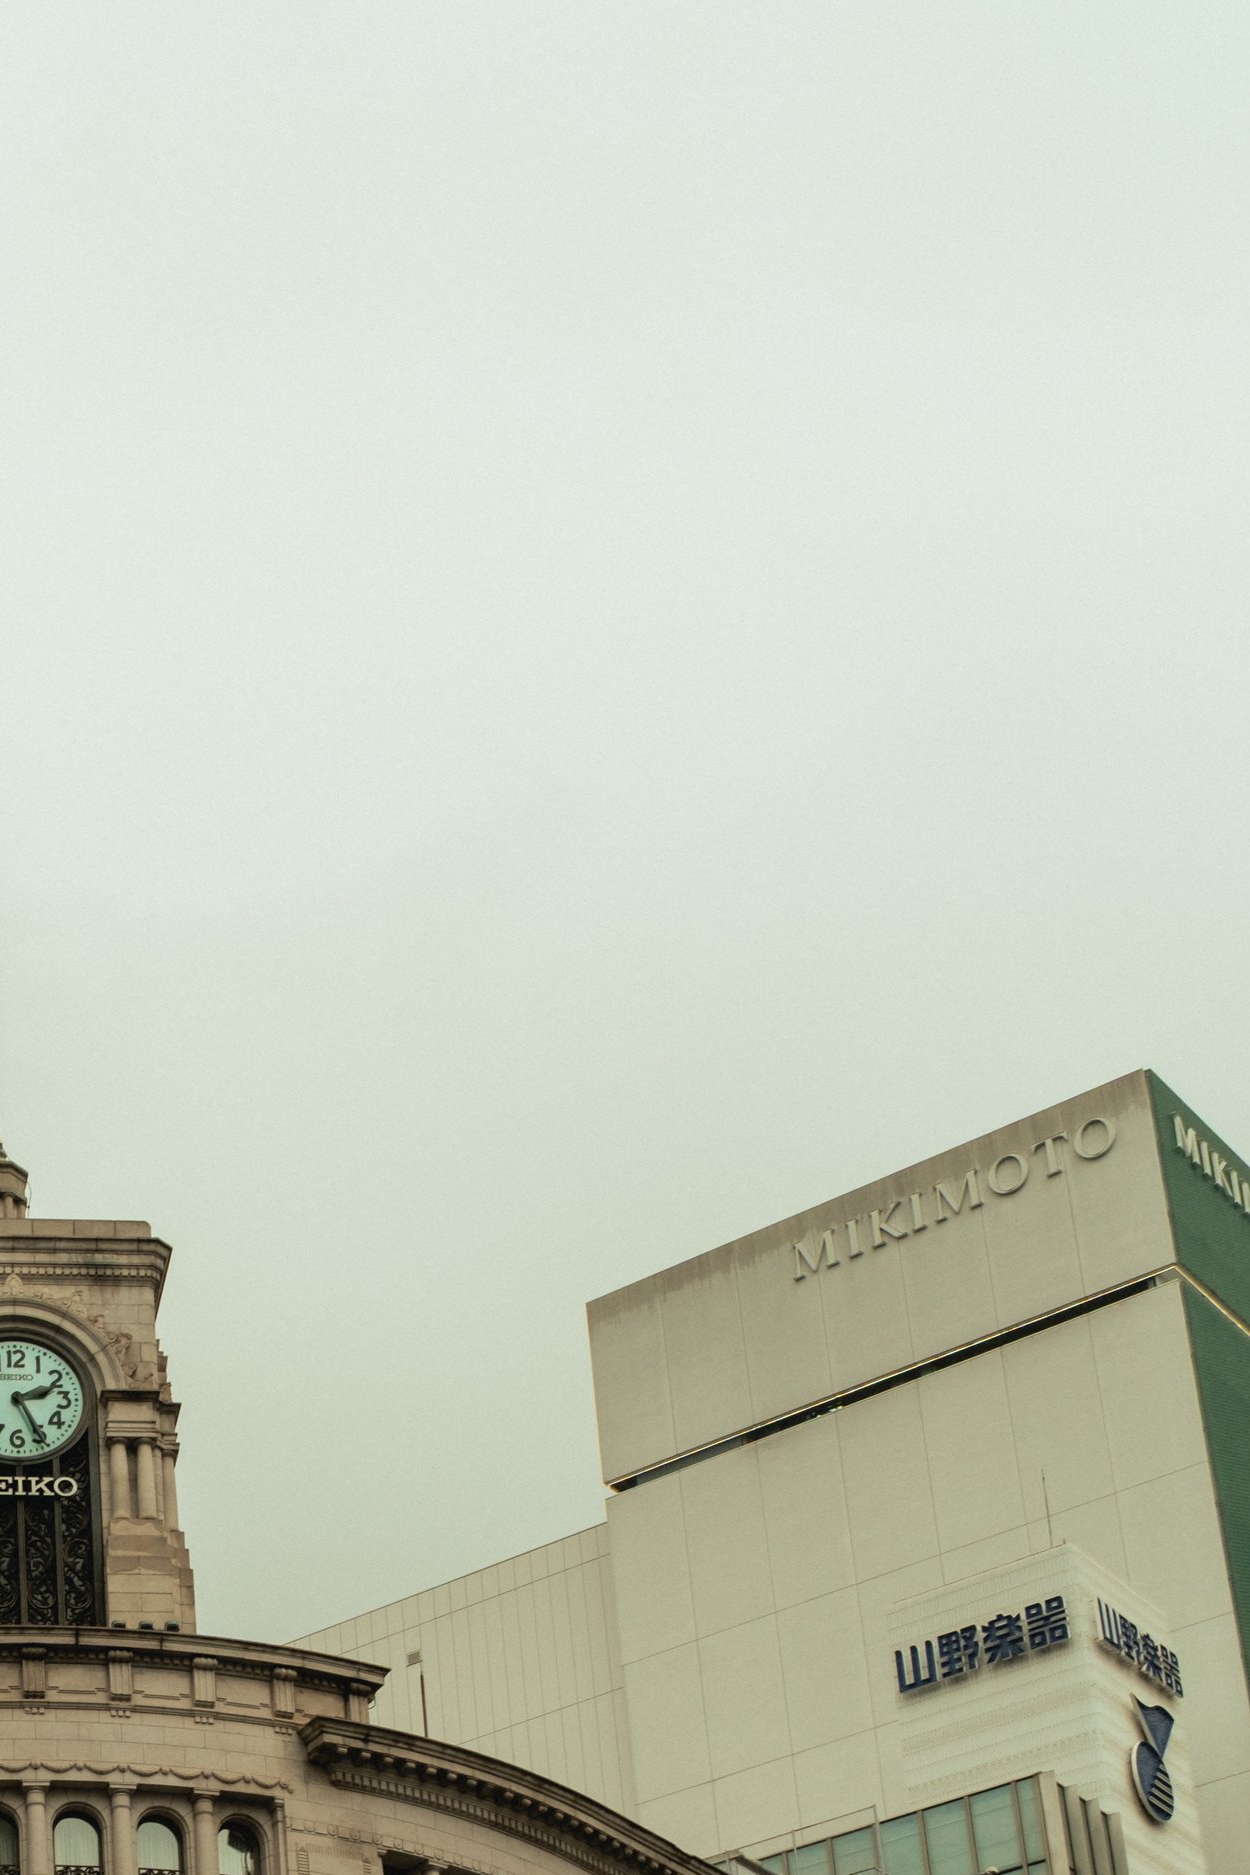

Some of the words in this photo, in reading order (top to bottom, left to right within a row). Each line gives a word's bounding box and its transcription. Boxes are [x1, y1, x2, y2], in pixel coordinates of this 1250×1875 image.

[791, 1115, 1118, 1282] MIKIMOTO
[6, 1350, 26, 1368] 12
[34, 1356, 42, 1374] 1
[48, 1369, 63, 1388] 2
[56, 1391, 72, 1410] 3
[48, 1410, 66, 1430] 4
[9, 1429, 26, 1449] 6
[893, 1594, 1070, 1695] 山野楽器
[1094, 1596, 1184, 1699] 山野楽器
